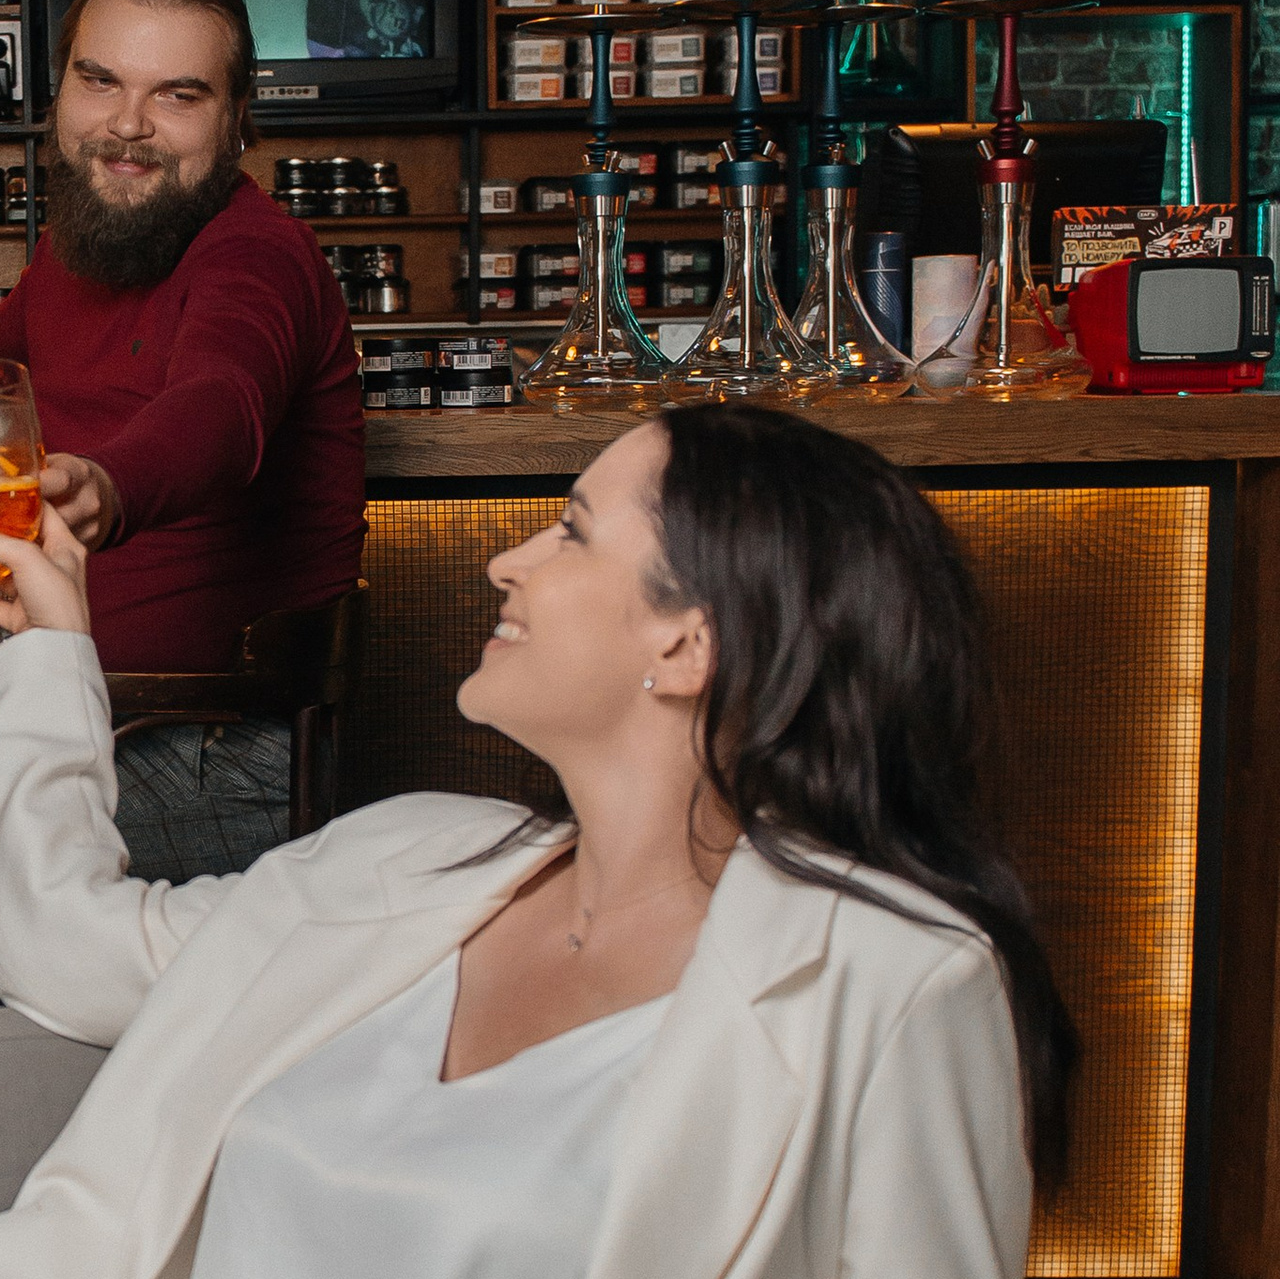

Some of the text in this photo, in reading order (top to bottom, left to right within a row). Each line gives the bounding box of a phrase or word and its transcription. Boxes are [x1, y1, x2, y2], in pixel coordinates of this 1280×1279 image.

[1065, 240, 1138, 252] ТО ПОЗВОНИТЕ
[1064, 252, 1123, 263] ПО НОМЕРУ
